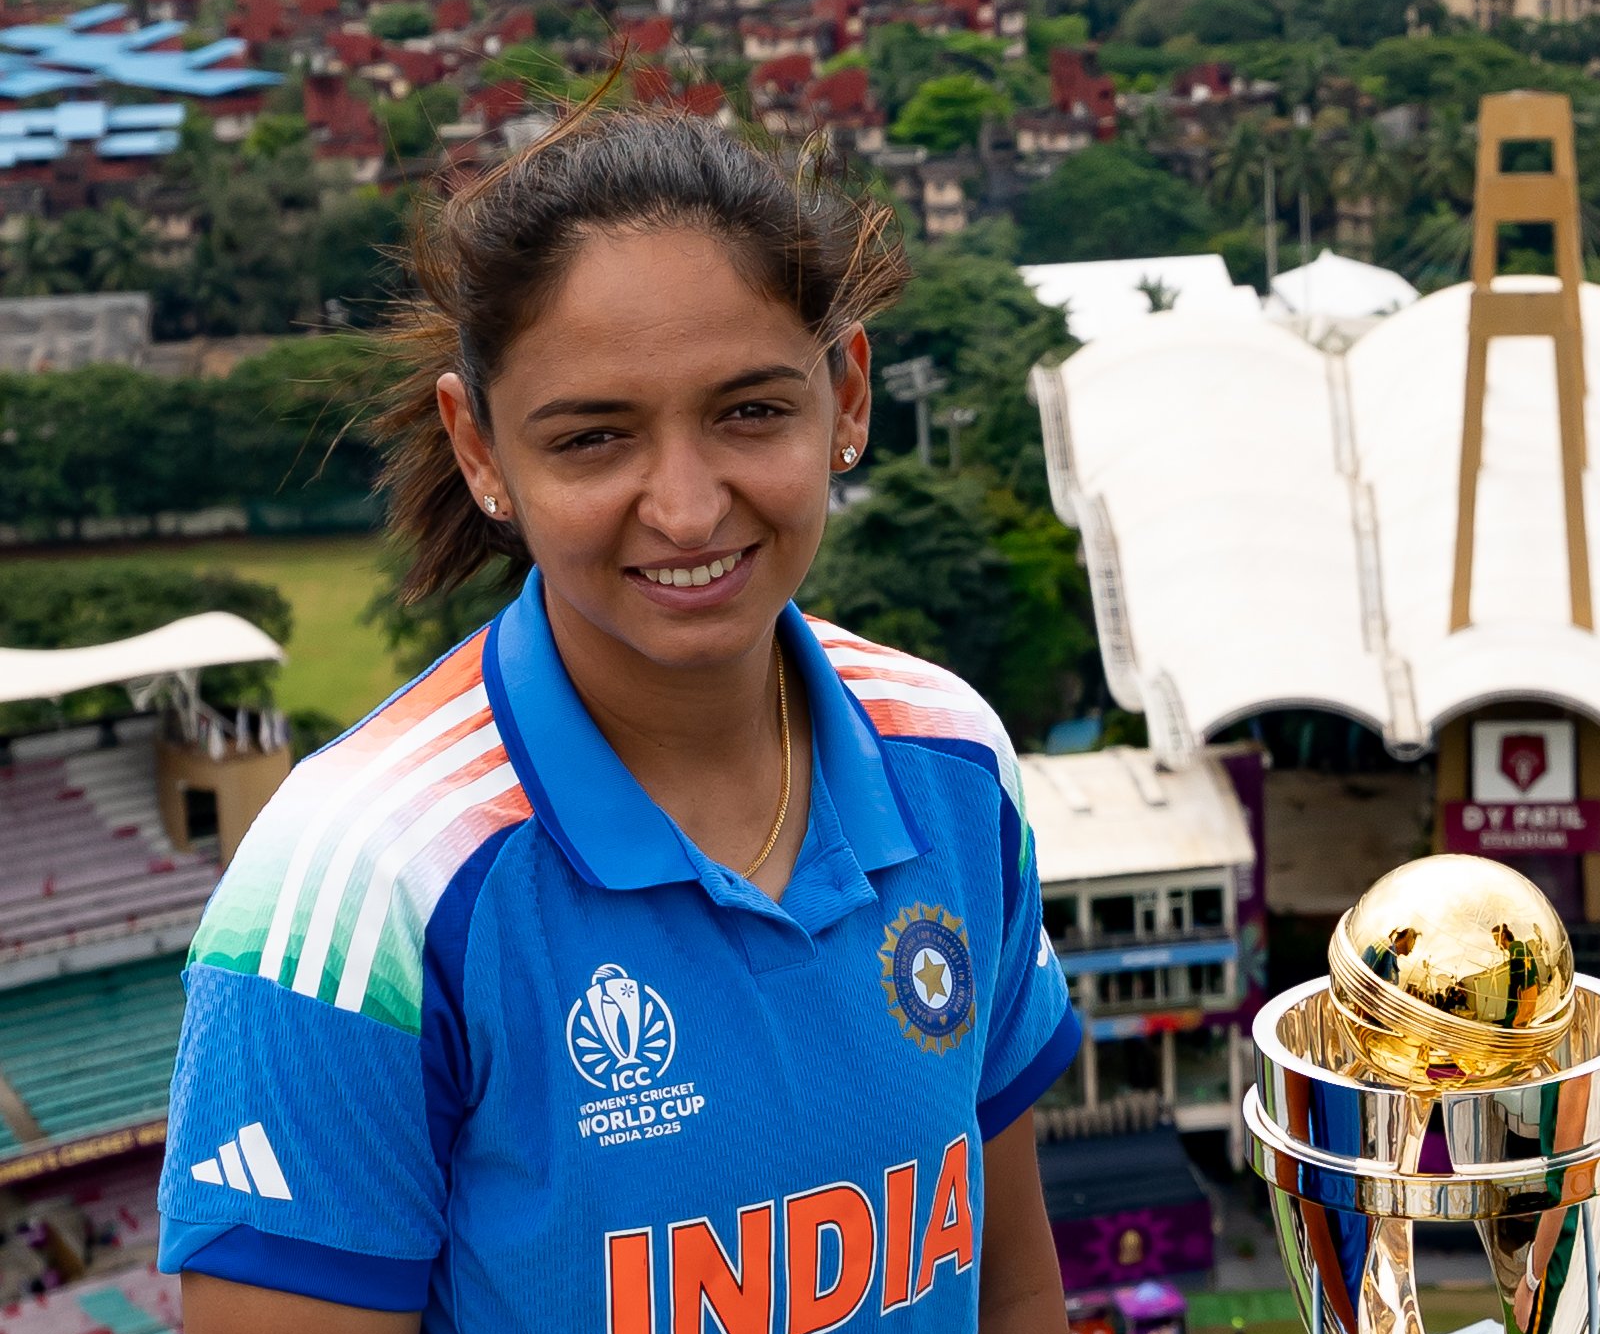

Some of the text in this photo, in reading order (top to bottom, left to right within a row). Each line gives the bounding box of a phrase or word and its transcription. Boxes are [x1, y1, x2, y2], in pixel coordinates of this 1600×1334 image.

[611, 1067, 652, 1091] ICC
[640, 1082, 695, 1102] CRICKET
[578, 1095, 705, 1138] WORLD CUP
[599, 1122, 681, 1147] INDIA 2025
